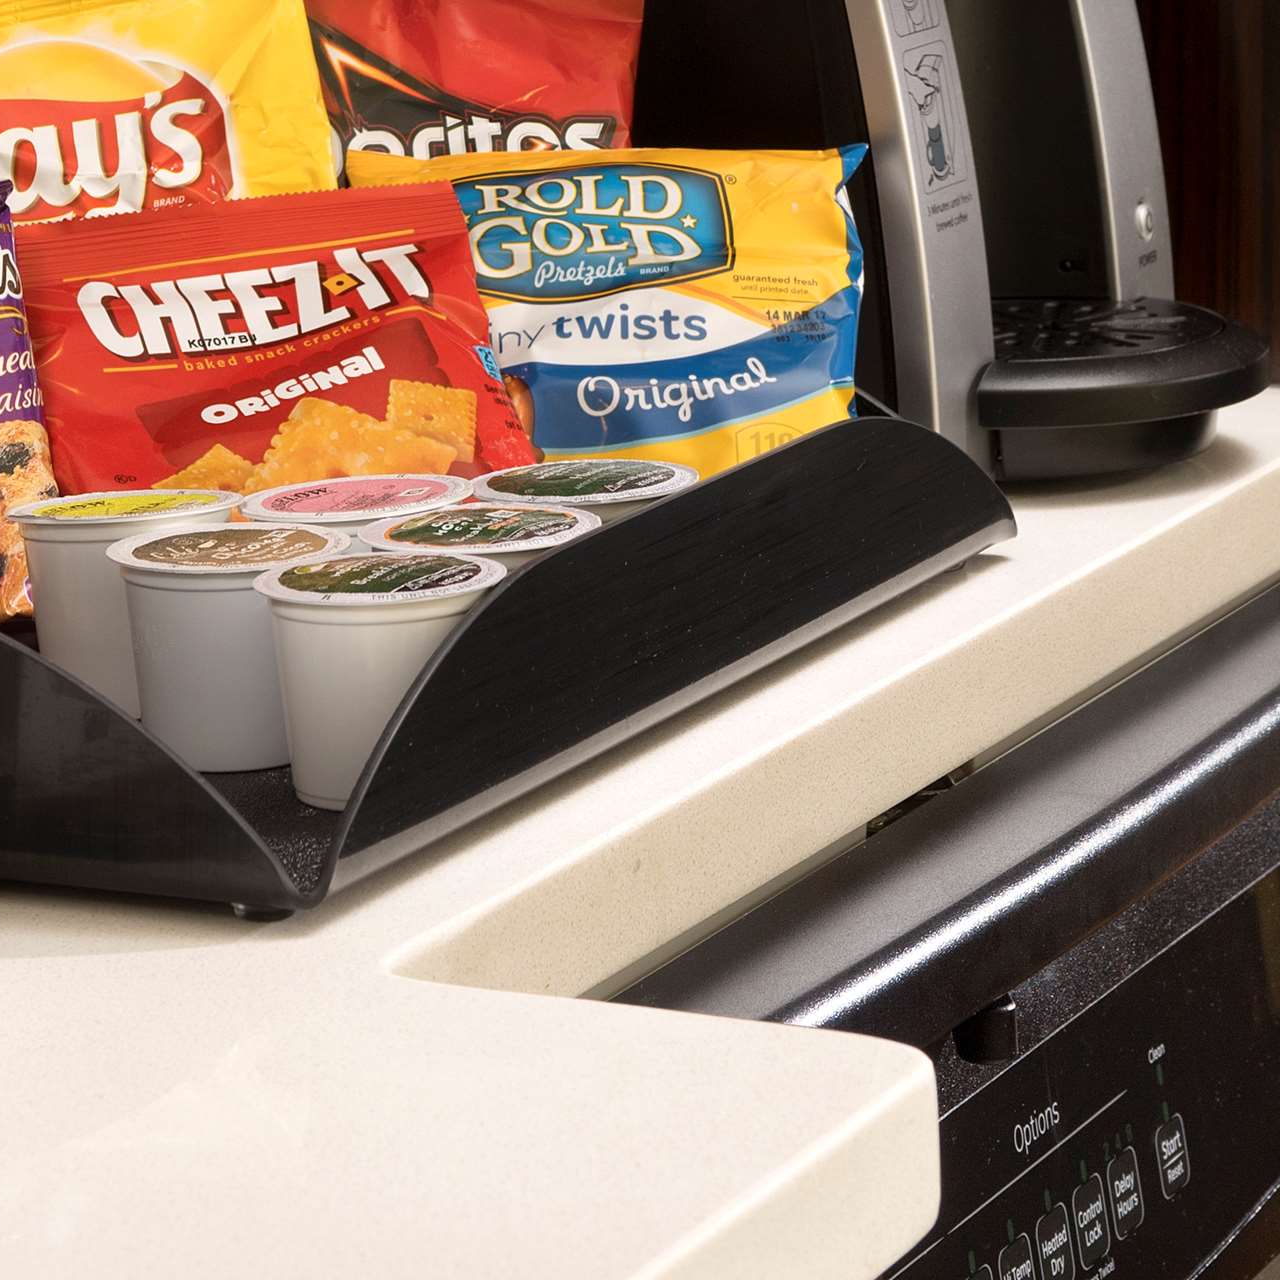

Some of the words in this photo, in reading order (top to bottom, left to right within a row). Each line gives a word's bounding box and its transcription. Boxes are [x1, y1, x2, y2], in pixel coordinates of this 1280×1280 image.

[331, 115, 606, 165] oritos
[153, 195, 186, 208] BRAND
[475, 175, 683, 219] ROLD
[469, 216, 703, 279] GOLD
[534, 256, 626, 287] Pretzels
[639, 265, 670, 275] BRAND
[733, 274, 790, 283] guaranteed
[794, 277, 818, 287] fresh
[759, 285, 789, 294] printed
[489, 322, 546, 354] iny
[553, 304, 708, 341] twists
[766, 310, 780, 320] 14
[783, 311, 810, 321] MAR
[183, 357, 238, 372] baked
[246, 344, 297, 364] snack
[303, 314, 382, 349] crackers
[577, 357, 777, 422] Original
[1147, 1043, 1166, 1064] Clean
[1013, 1101, 1060, 1154] Options
[1161, 1129, 1183, 1160] Start
[1113, 1171, 1135, 1198] Delay
[1167, 1161, 1185, 1183] Reset
[1077, 1194, 1103, 1228] Control
[1116, 1192, 1139, 1219] Hours
[1041, 1224, 1068, 1259] Heated
[1084, 1220, 1103, 1247] Lock
[1012, 1259, 1032, 1279] Temp
[1050, 1254, 1065, 1276] Dry
